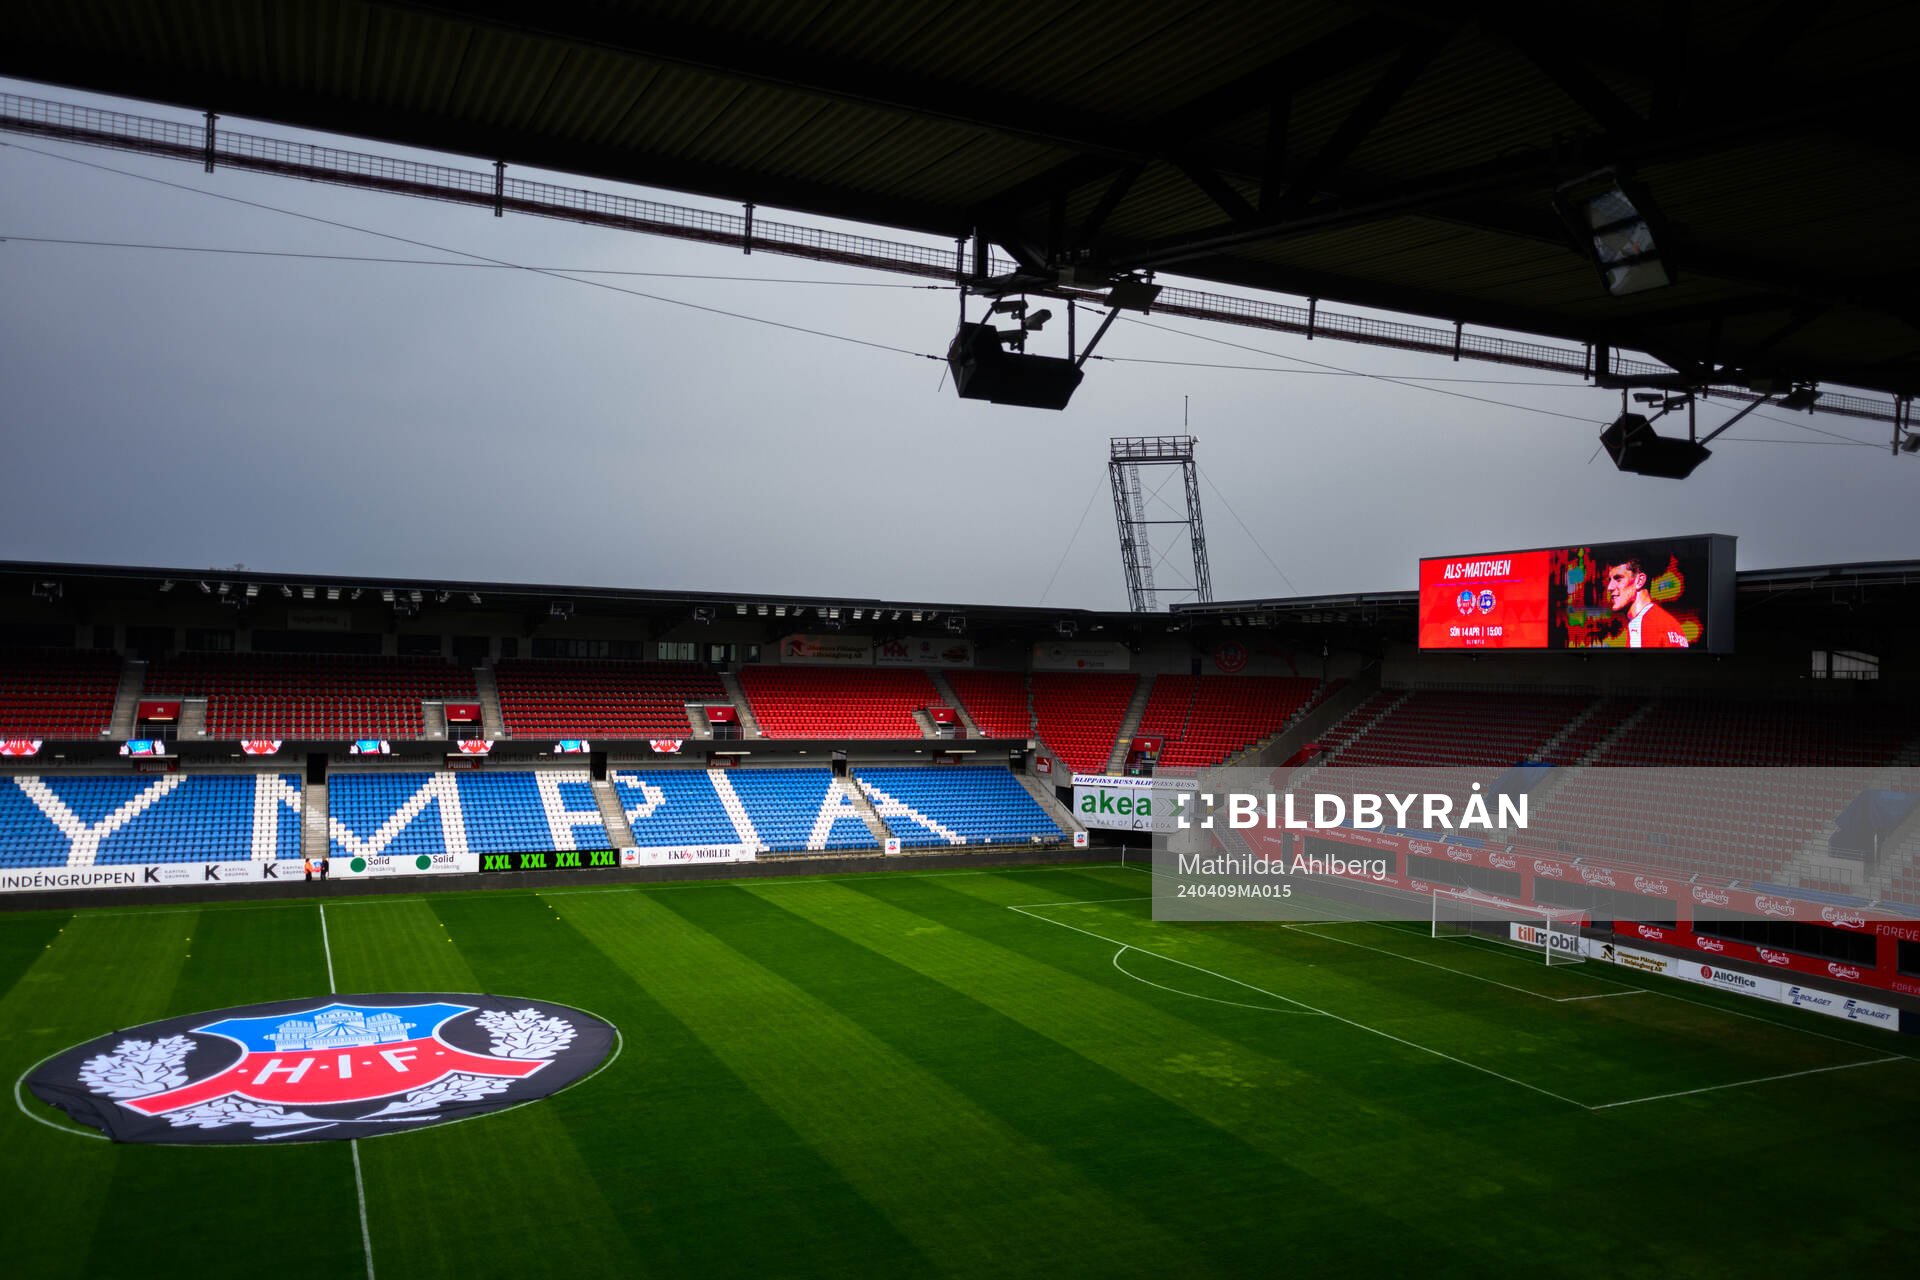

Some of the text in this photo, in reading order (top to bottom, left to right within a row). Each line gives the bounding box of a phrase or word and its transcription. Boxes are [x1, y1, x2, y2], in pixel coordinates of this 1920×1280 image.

[1444, 559, 1511, 579] ALS-MATCHEN
[1450, 626, 1503, 637] SÖN 14 APR 15:00
[1081, 789, 1152, 816] akea
[368, 857, 390, 865] Solid
[433, 855, 454, 863] Solid
[484, 850, 616, 870] XXL XXL XXL XXL
[696, 847, 731, 859] MÖBLER
[1488, 852, 1516, 868] Carlsberg
[1533, 860, 1562, 876] Carlsberg
[1634, 876, 1668, 895] Carlsberg
[1692, 885, 1729, 905] Carlsberg
[1755, 895, 1795, 917] Carlsberg
[1821, 906, 1865, 928] Carlsberg
[1638, 925, 1663, 939] Carlsberg
[1696, 936, 1724, 951] Carlsberg
[1760, 949, 1790, 965] Carlsberg
[1828, 962, 1860, 979] Carlsberg
[1713, 970, 1756, 988] AllOffice
